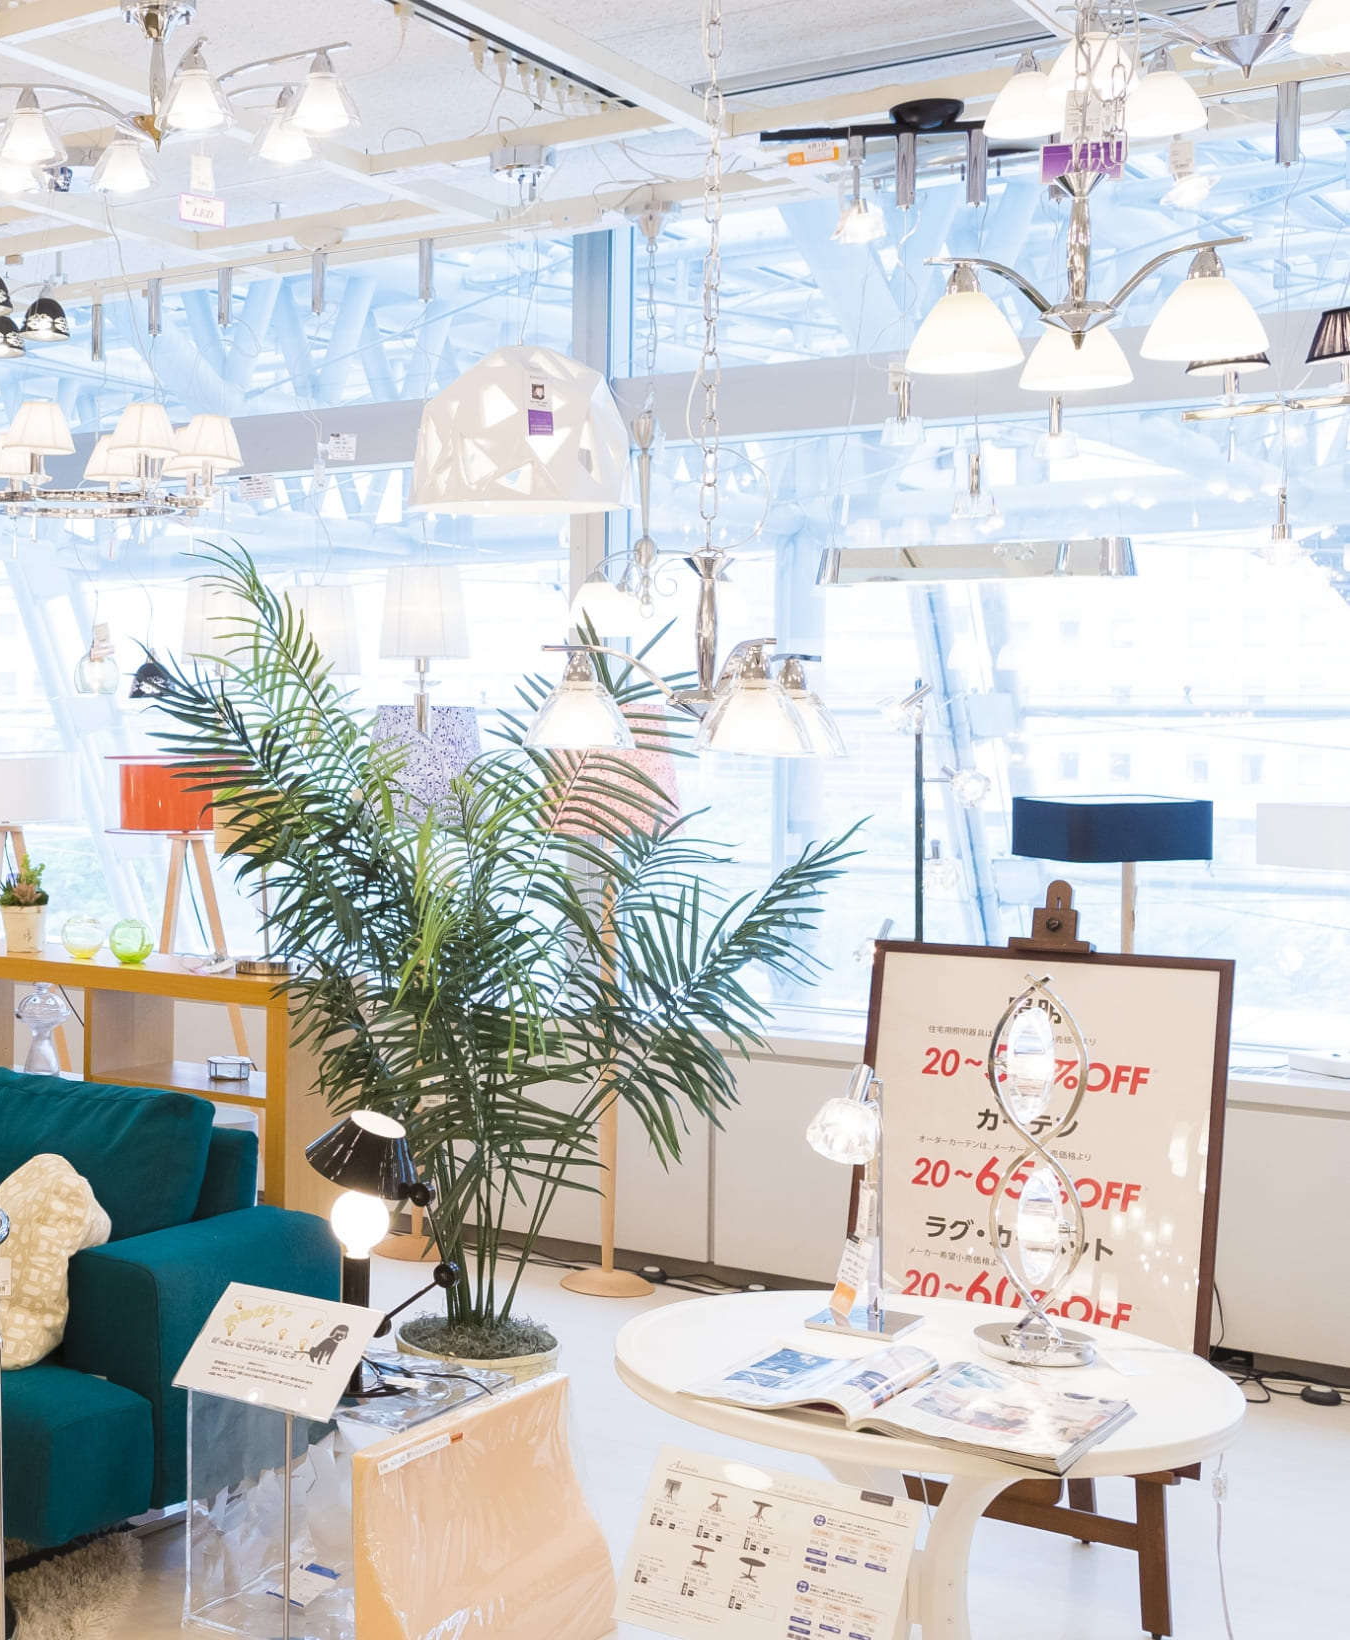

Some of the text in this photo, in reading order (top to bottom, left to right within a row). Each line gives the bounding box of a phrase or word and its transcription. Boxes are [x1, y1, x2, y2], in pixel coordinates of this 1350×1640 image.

[908, 1246, 1000, 1267] メーカー希望小売価格よ
